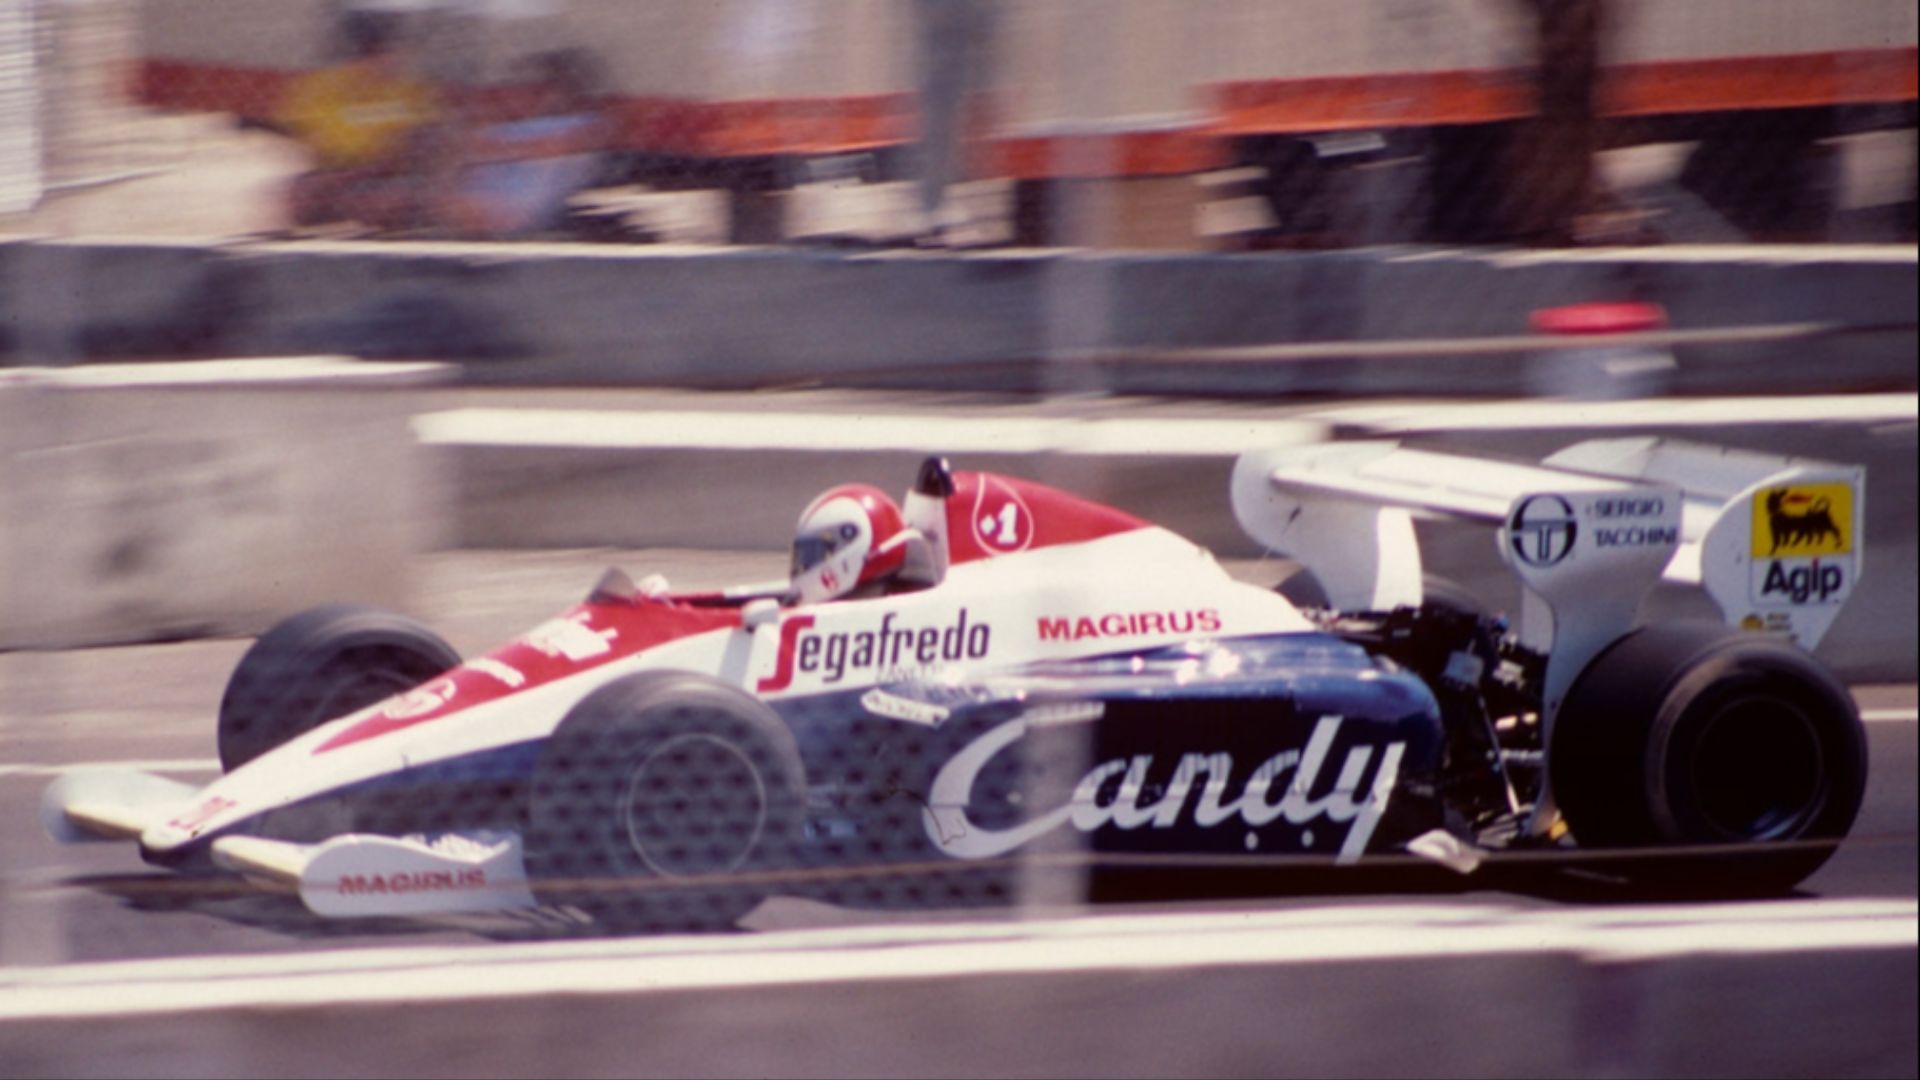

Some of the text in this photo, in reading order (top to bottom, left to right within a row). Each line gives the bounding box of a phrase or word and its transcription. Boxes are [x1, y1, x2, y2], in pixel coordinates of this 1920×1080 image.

[1594, 498, 1664, 517] SERGIO
[1761, 557, 1843, 606] Agip
[1037, 607, 1223, 642] MAGIRUS
[756, 607, 991, 693] Segafredo
[922, 703, 1406, 865] Candy
[337, 867, 487, 897] MAGIRUS
